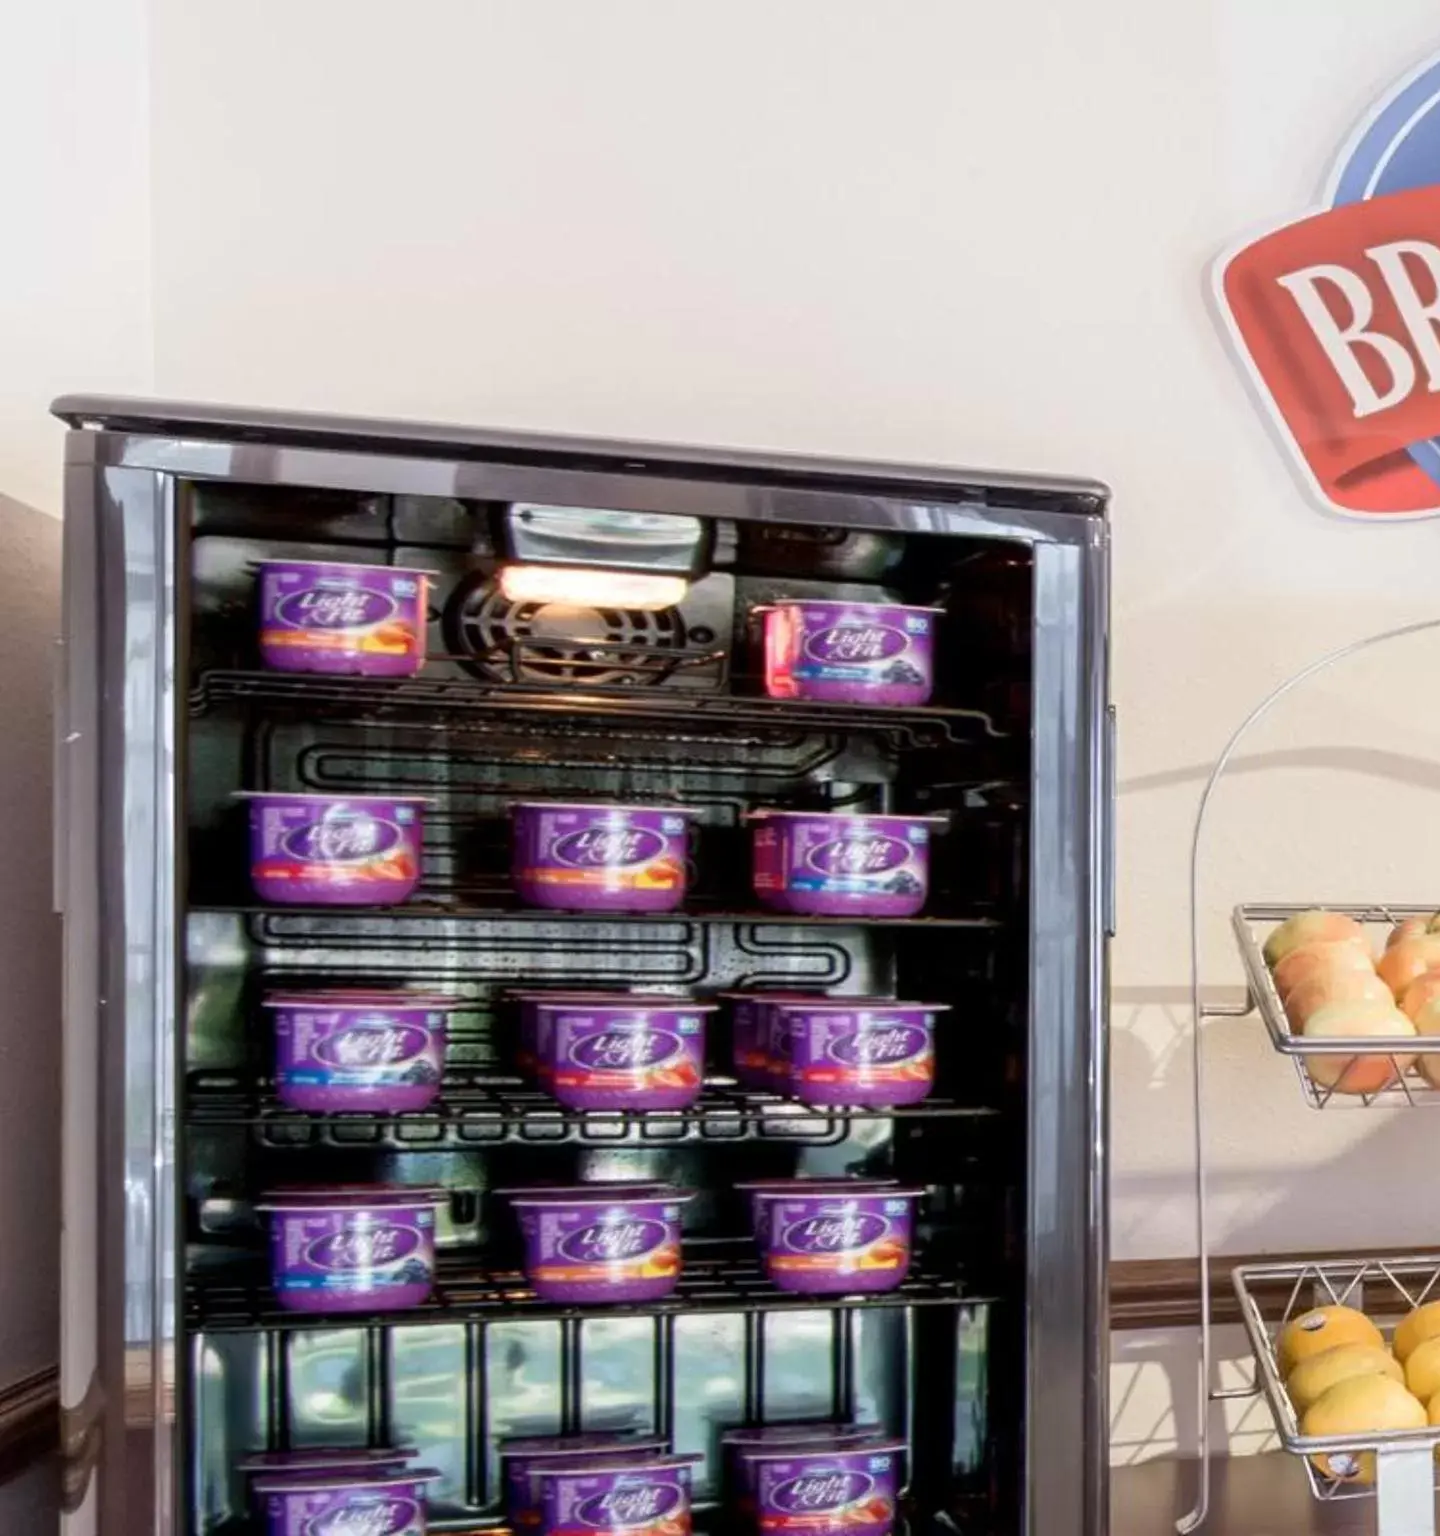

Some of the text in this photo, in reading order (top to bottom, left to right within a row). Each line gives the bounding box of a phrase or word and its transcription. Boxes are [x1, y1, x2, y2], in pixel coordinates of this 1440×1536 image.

[299, 592, 371, 610] Light
[826, 629, 887, 647] Light
[851, 644, 885, 660] Fit
[791, 1474, 852, 1494] Light
